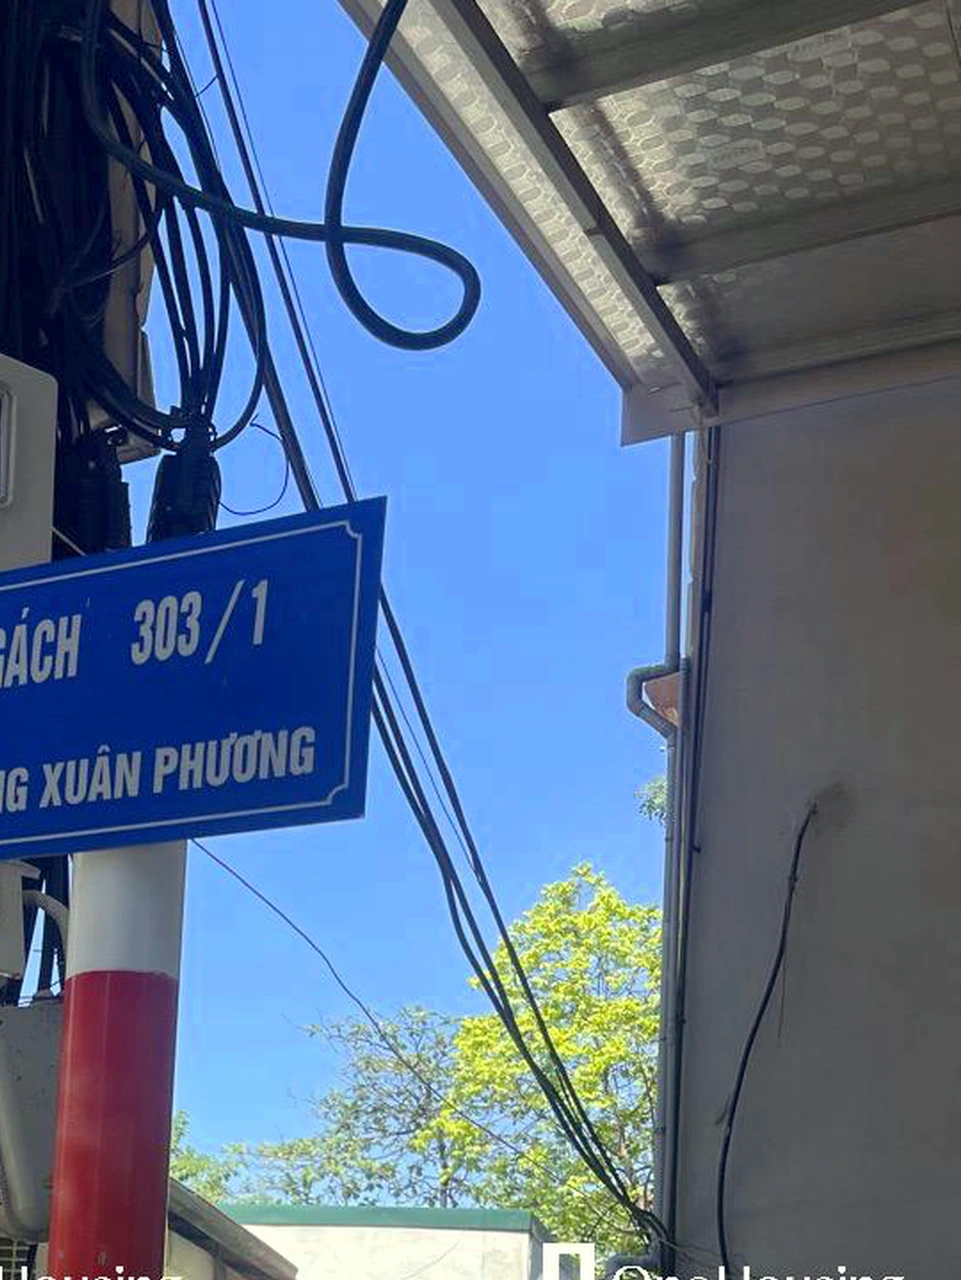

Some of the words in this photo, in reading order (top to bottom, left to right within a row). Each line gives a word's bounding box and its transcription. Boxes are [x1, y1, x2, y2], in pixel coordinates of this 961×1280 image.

[130, 579, 269, 664] 303/1
[40, 744, 141, 808] XUÂN
[153, 726, 315, 794] PHƯƠNG
